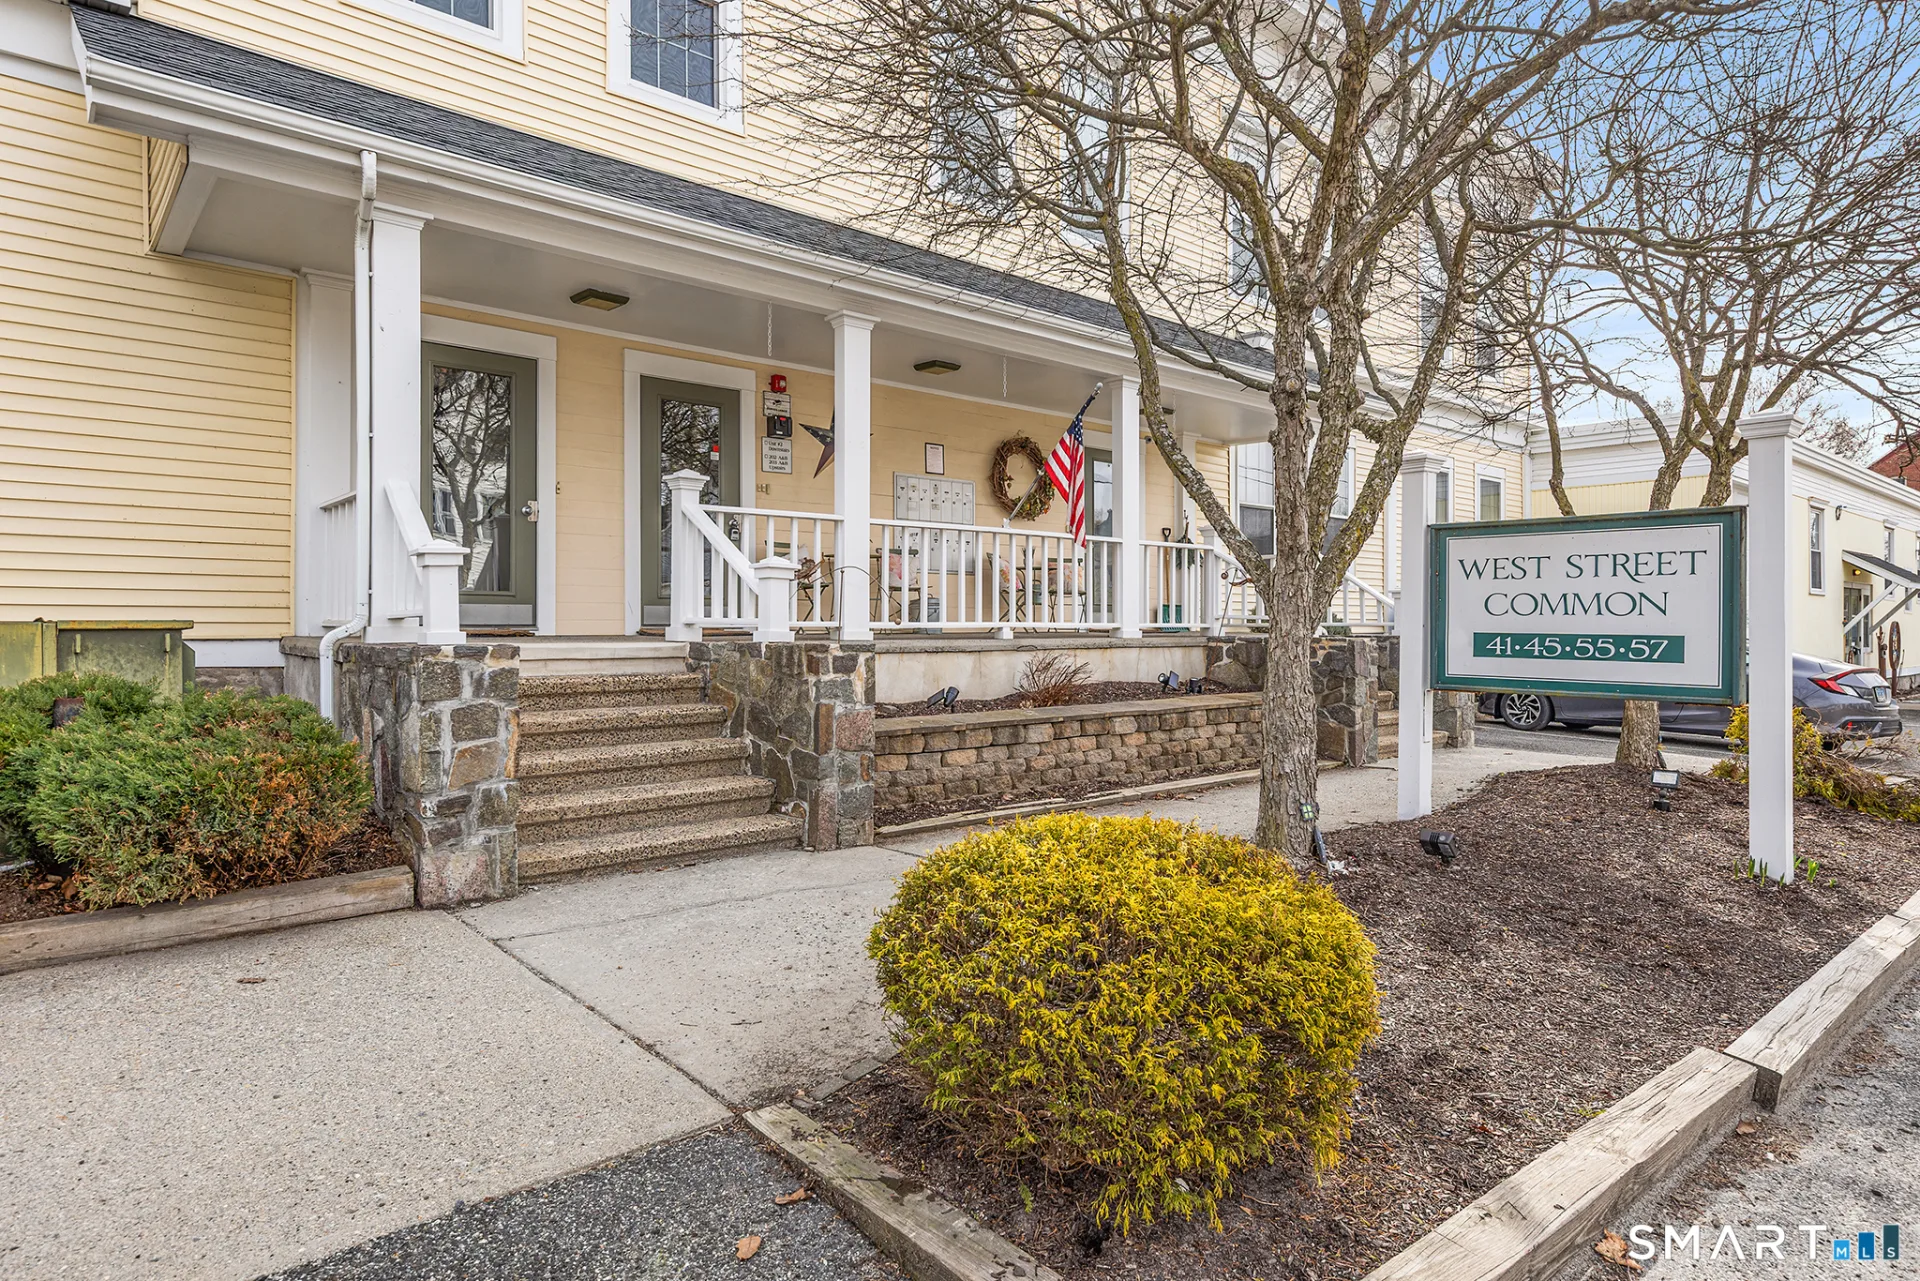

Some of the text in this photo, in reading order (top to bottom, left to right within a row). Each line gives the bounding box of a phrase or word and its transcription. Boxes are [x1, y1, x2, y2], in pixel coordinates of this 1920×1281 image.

[1457, 549, 1707, 584] WEST STREET
[1483, 591, 1669, 617] COMMON
